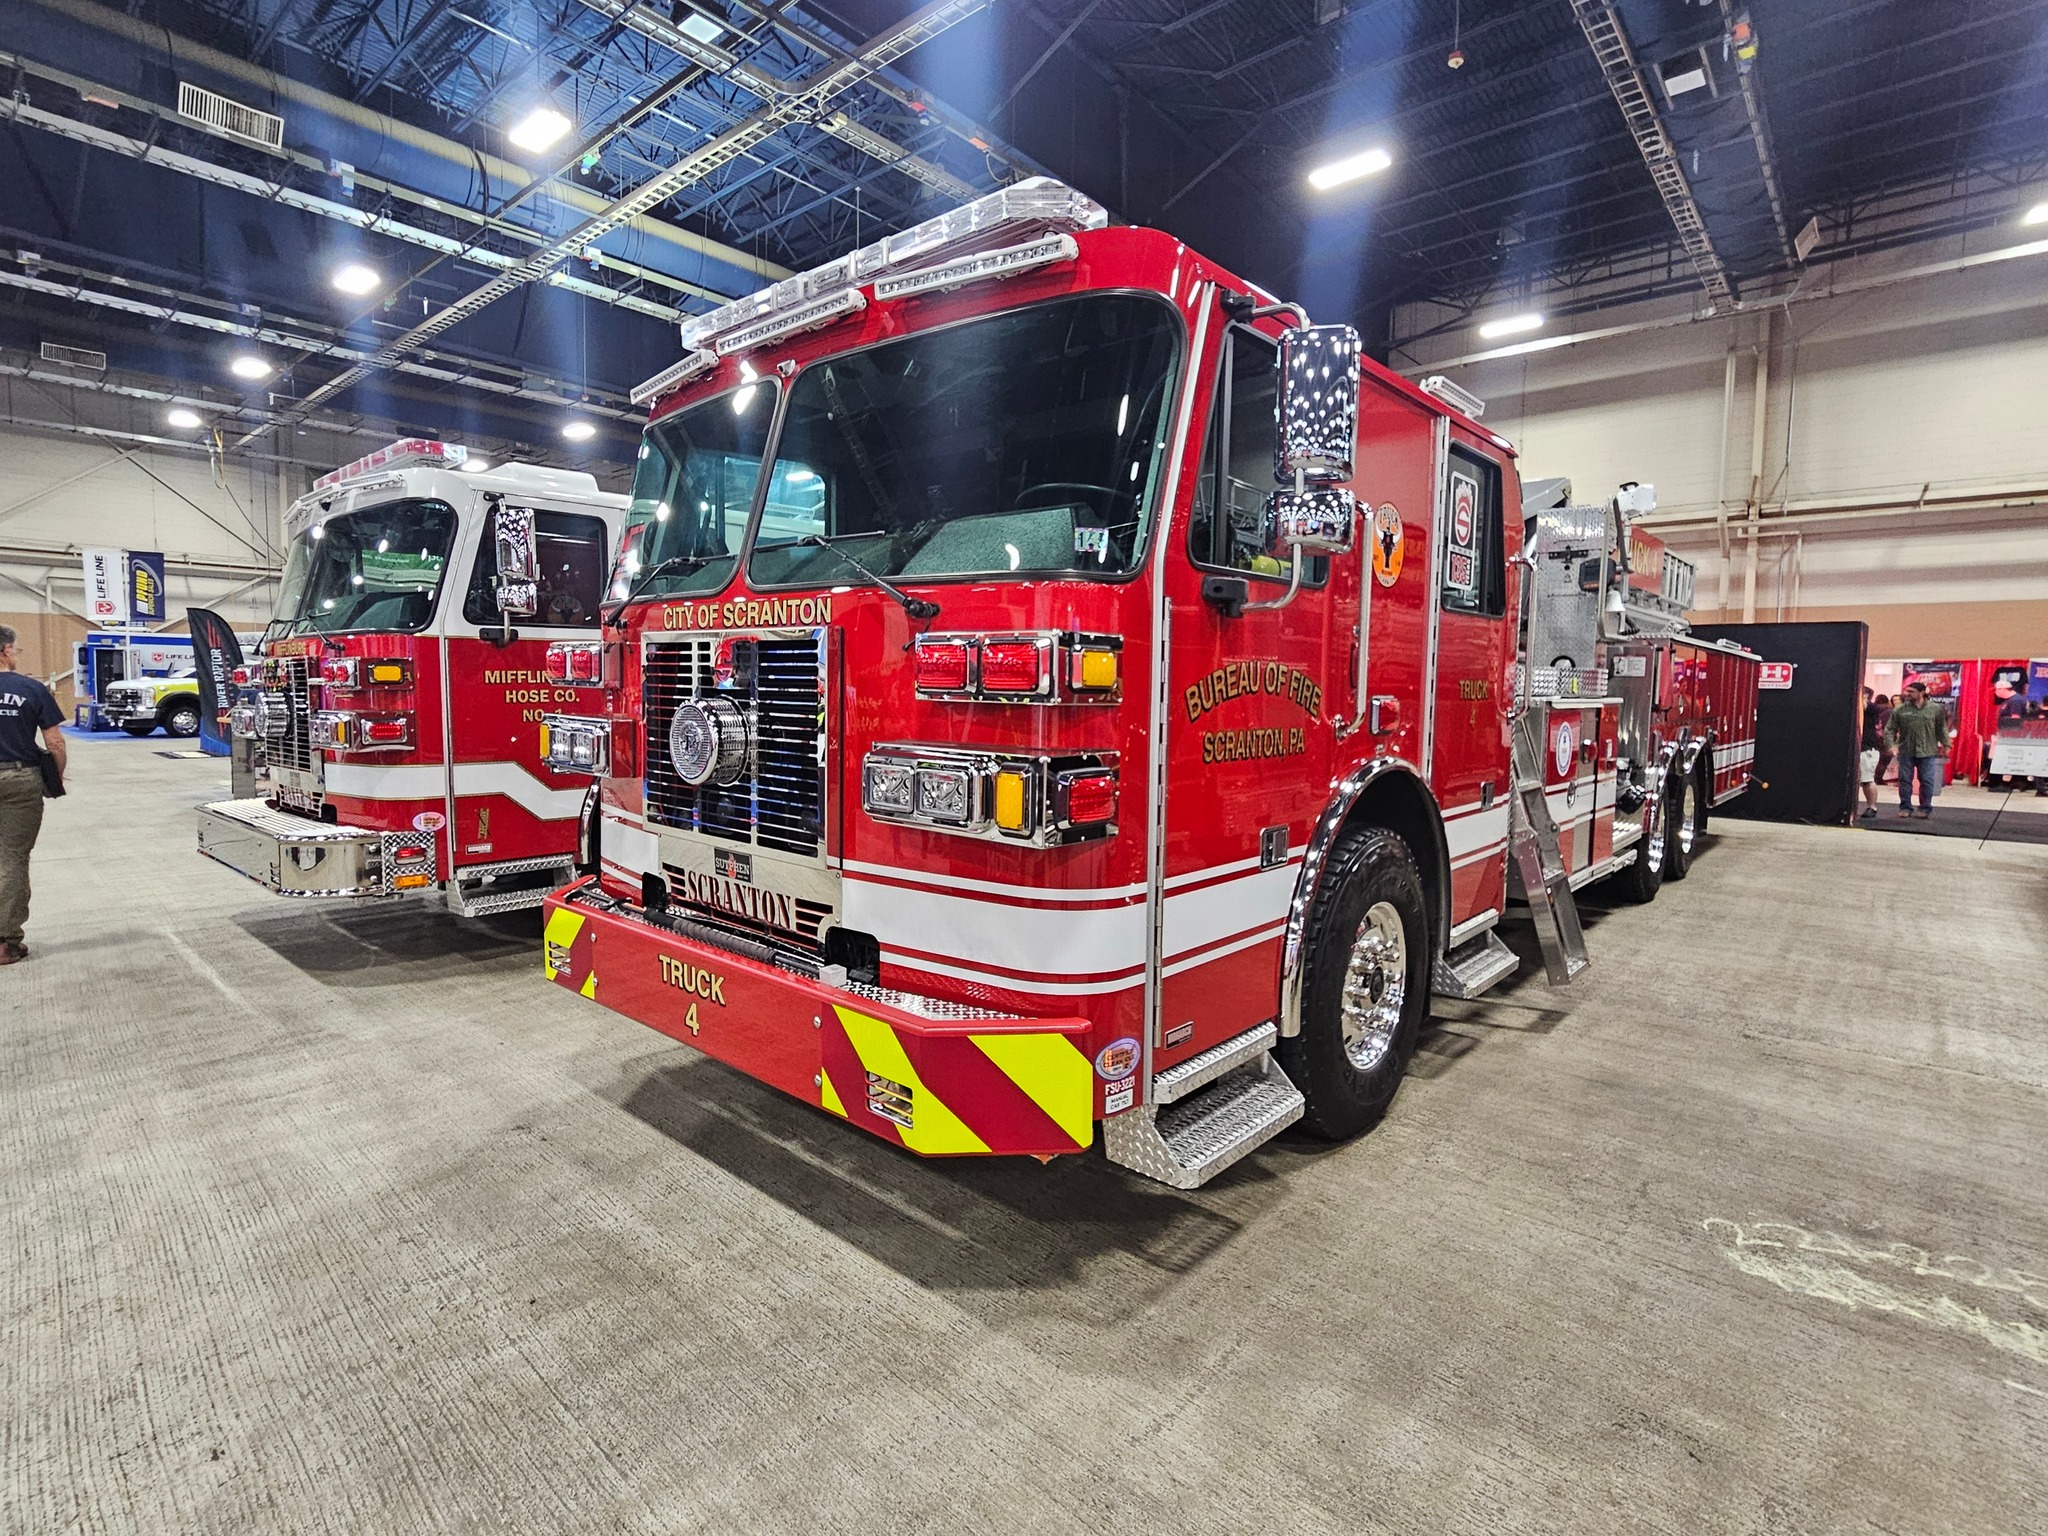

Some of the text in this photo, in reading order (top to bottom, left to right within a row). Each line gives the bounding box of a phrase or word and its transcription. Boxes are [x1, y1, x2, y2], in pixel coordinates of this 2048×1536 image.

[1628, 537, 1658, 579] UCK 4
[95, 555, 106, 599] LIFE LINE
[136, 569, 149, 602] PFUND
[663, 597, 832, 630] CITY OF SCRANTON
[210, 648, 229, 709] RIVER RAPTOR
[484, 670, 550, 684] MIFFLIN
[1185, 661, 1322, 722] BUREAU OF FIRE
[1459, 680, 1489, 701] TRUCK
[505, 689, 580, 703] HOSE CO.
[1469, 709, 1476, 728] 4
[1203, 728, 1305, 764] SCRANTON, PA
[715, 856, 750, 876] SUTPHEN
[687, 870, 791, 930] SCRANTON
[658, 954, 726, 1007] TRUCK
[684, 1002, 700, 1037] 4
[1105, 1076, 1135, 1096] FSU-3221
[1110, 1094, 1129, 1103] MANUAL
[1110, 1102, 1120, 1110] CAB
